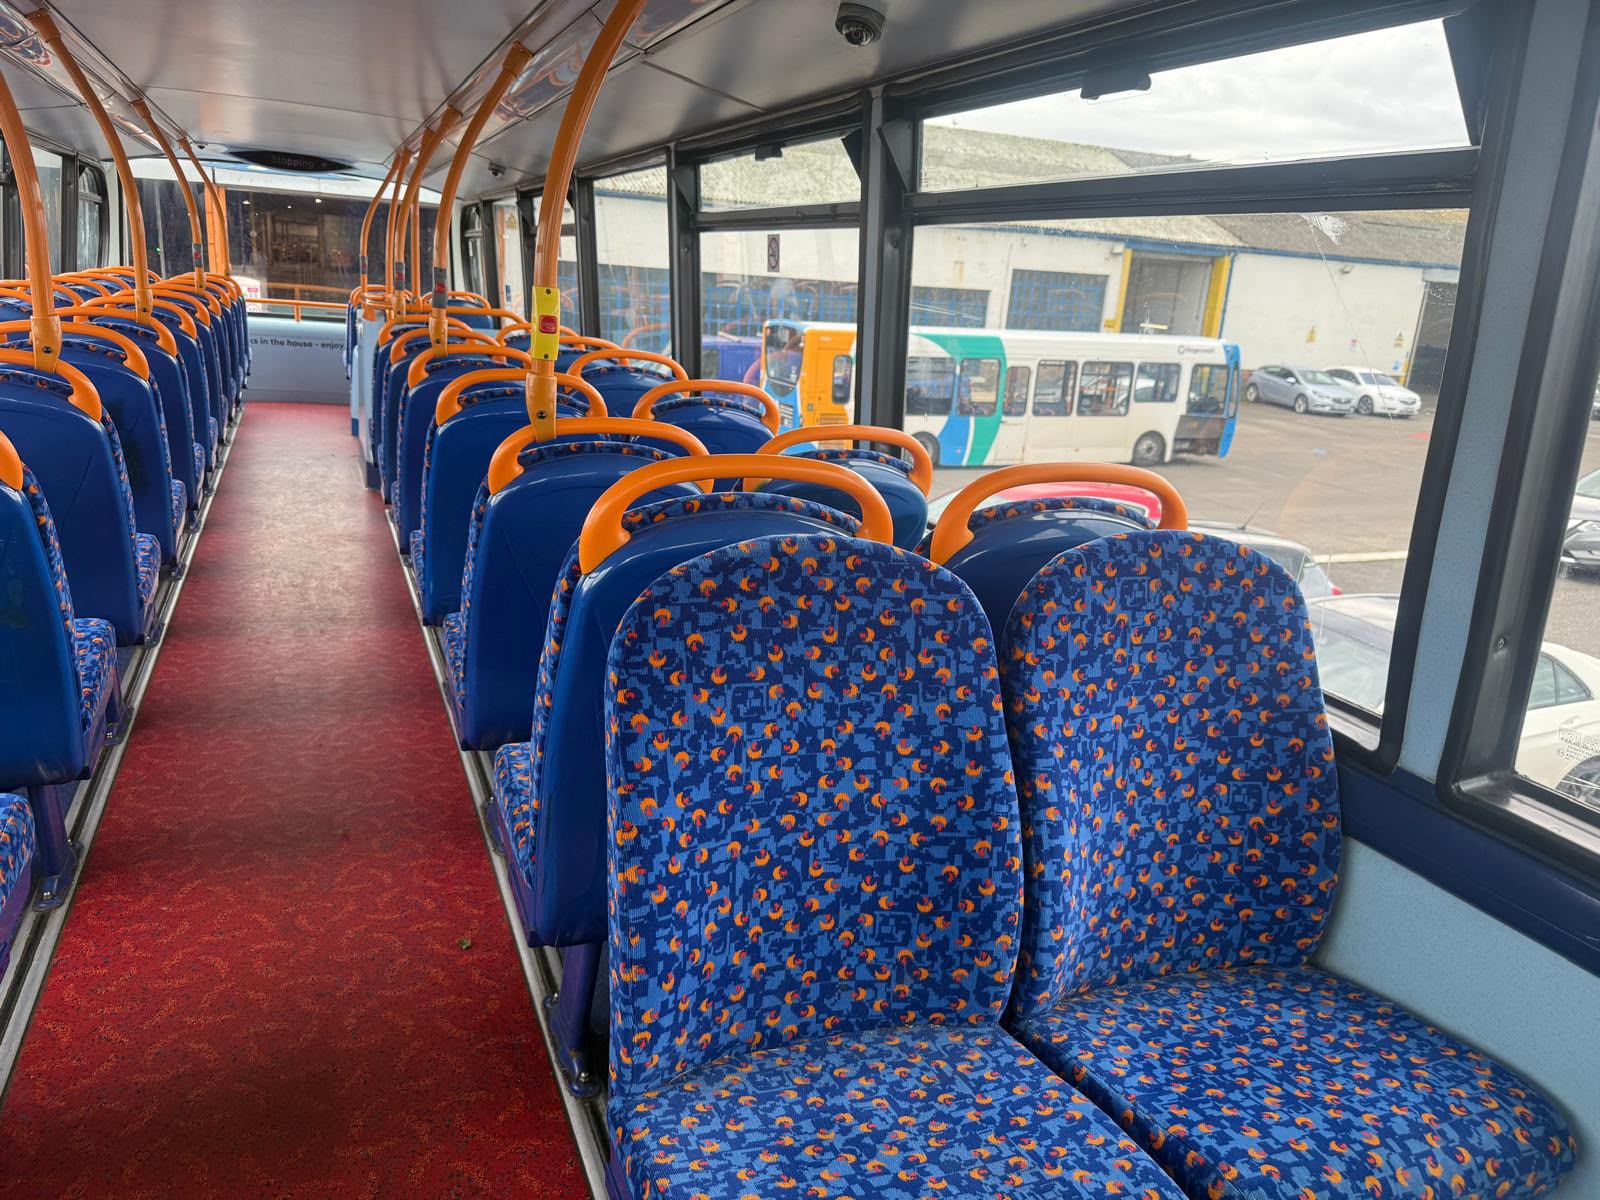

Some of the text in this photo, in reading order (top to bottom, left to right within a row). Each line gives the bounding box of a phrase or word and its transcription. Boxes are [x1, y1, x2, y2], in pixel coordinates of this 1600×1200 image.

[271, 153, 314, 169] Stopping
[260, 337, 269, 345] in
[270, 338, 285, 346] the
[287, 338, 313, 348] house
[320, 340, 345, 350] enjoy
